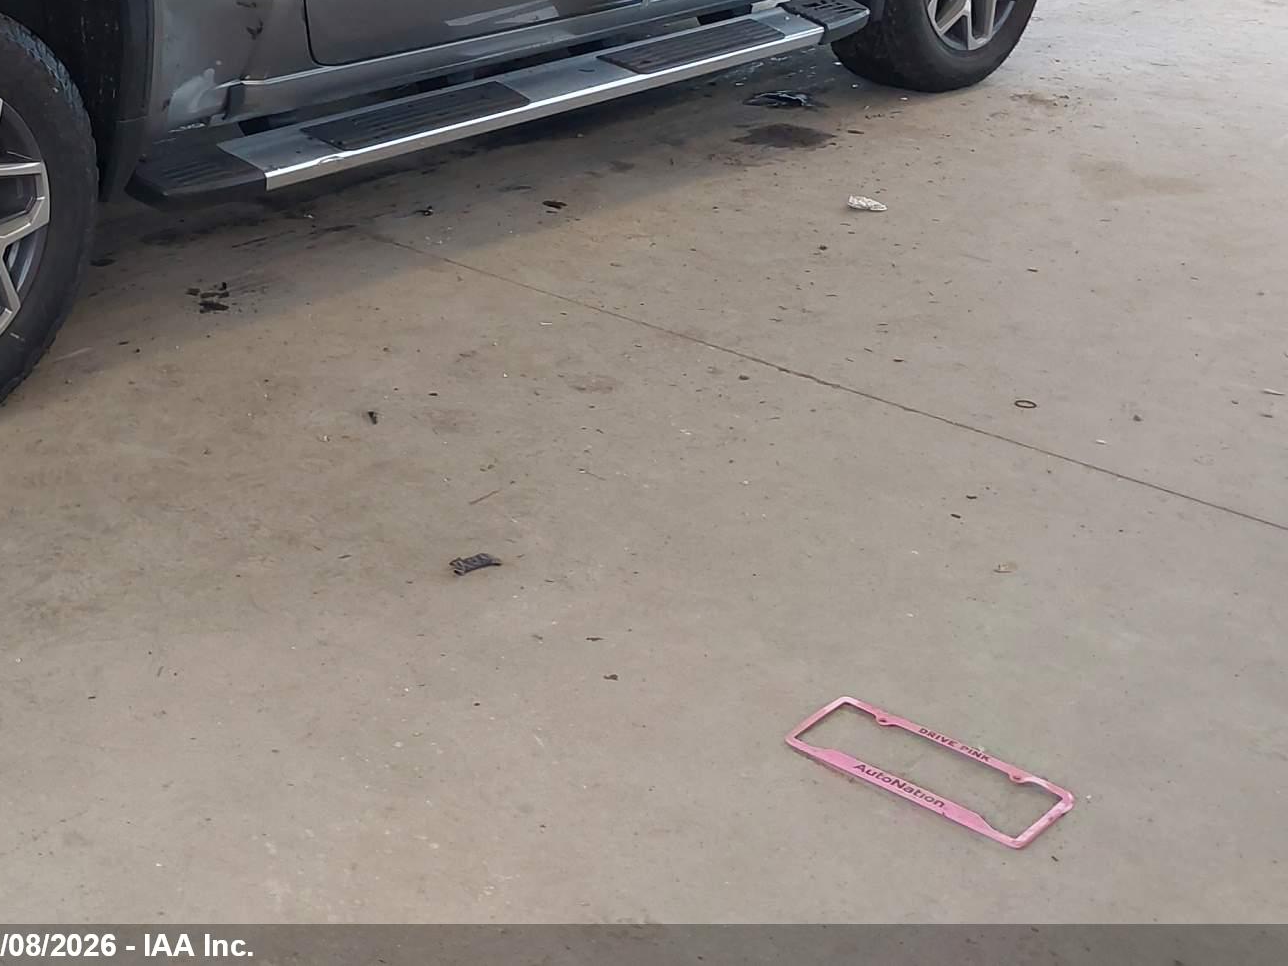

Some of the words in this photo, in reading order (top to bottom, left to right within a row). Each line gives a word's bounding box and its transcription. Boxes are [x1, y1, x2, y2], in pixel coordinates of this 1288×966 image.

[918, 727, 959, 747] DRIVE
[960, 745, 991, 763] PINK
[853, 763, 946, 809] AutoNation
